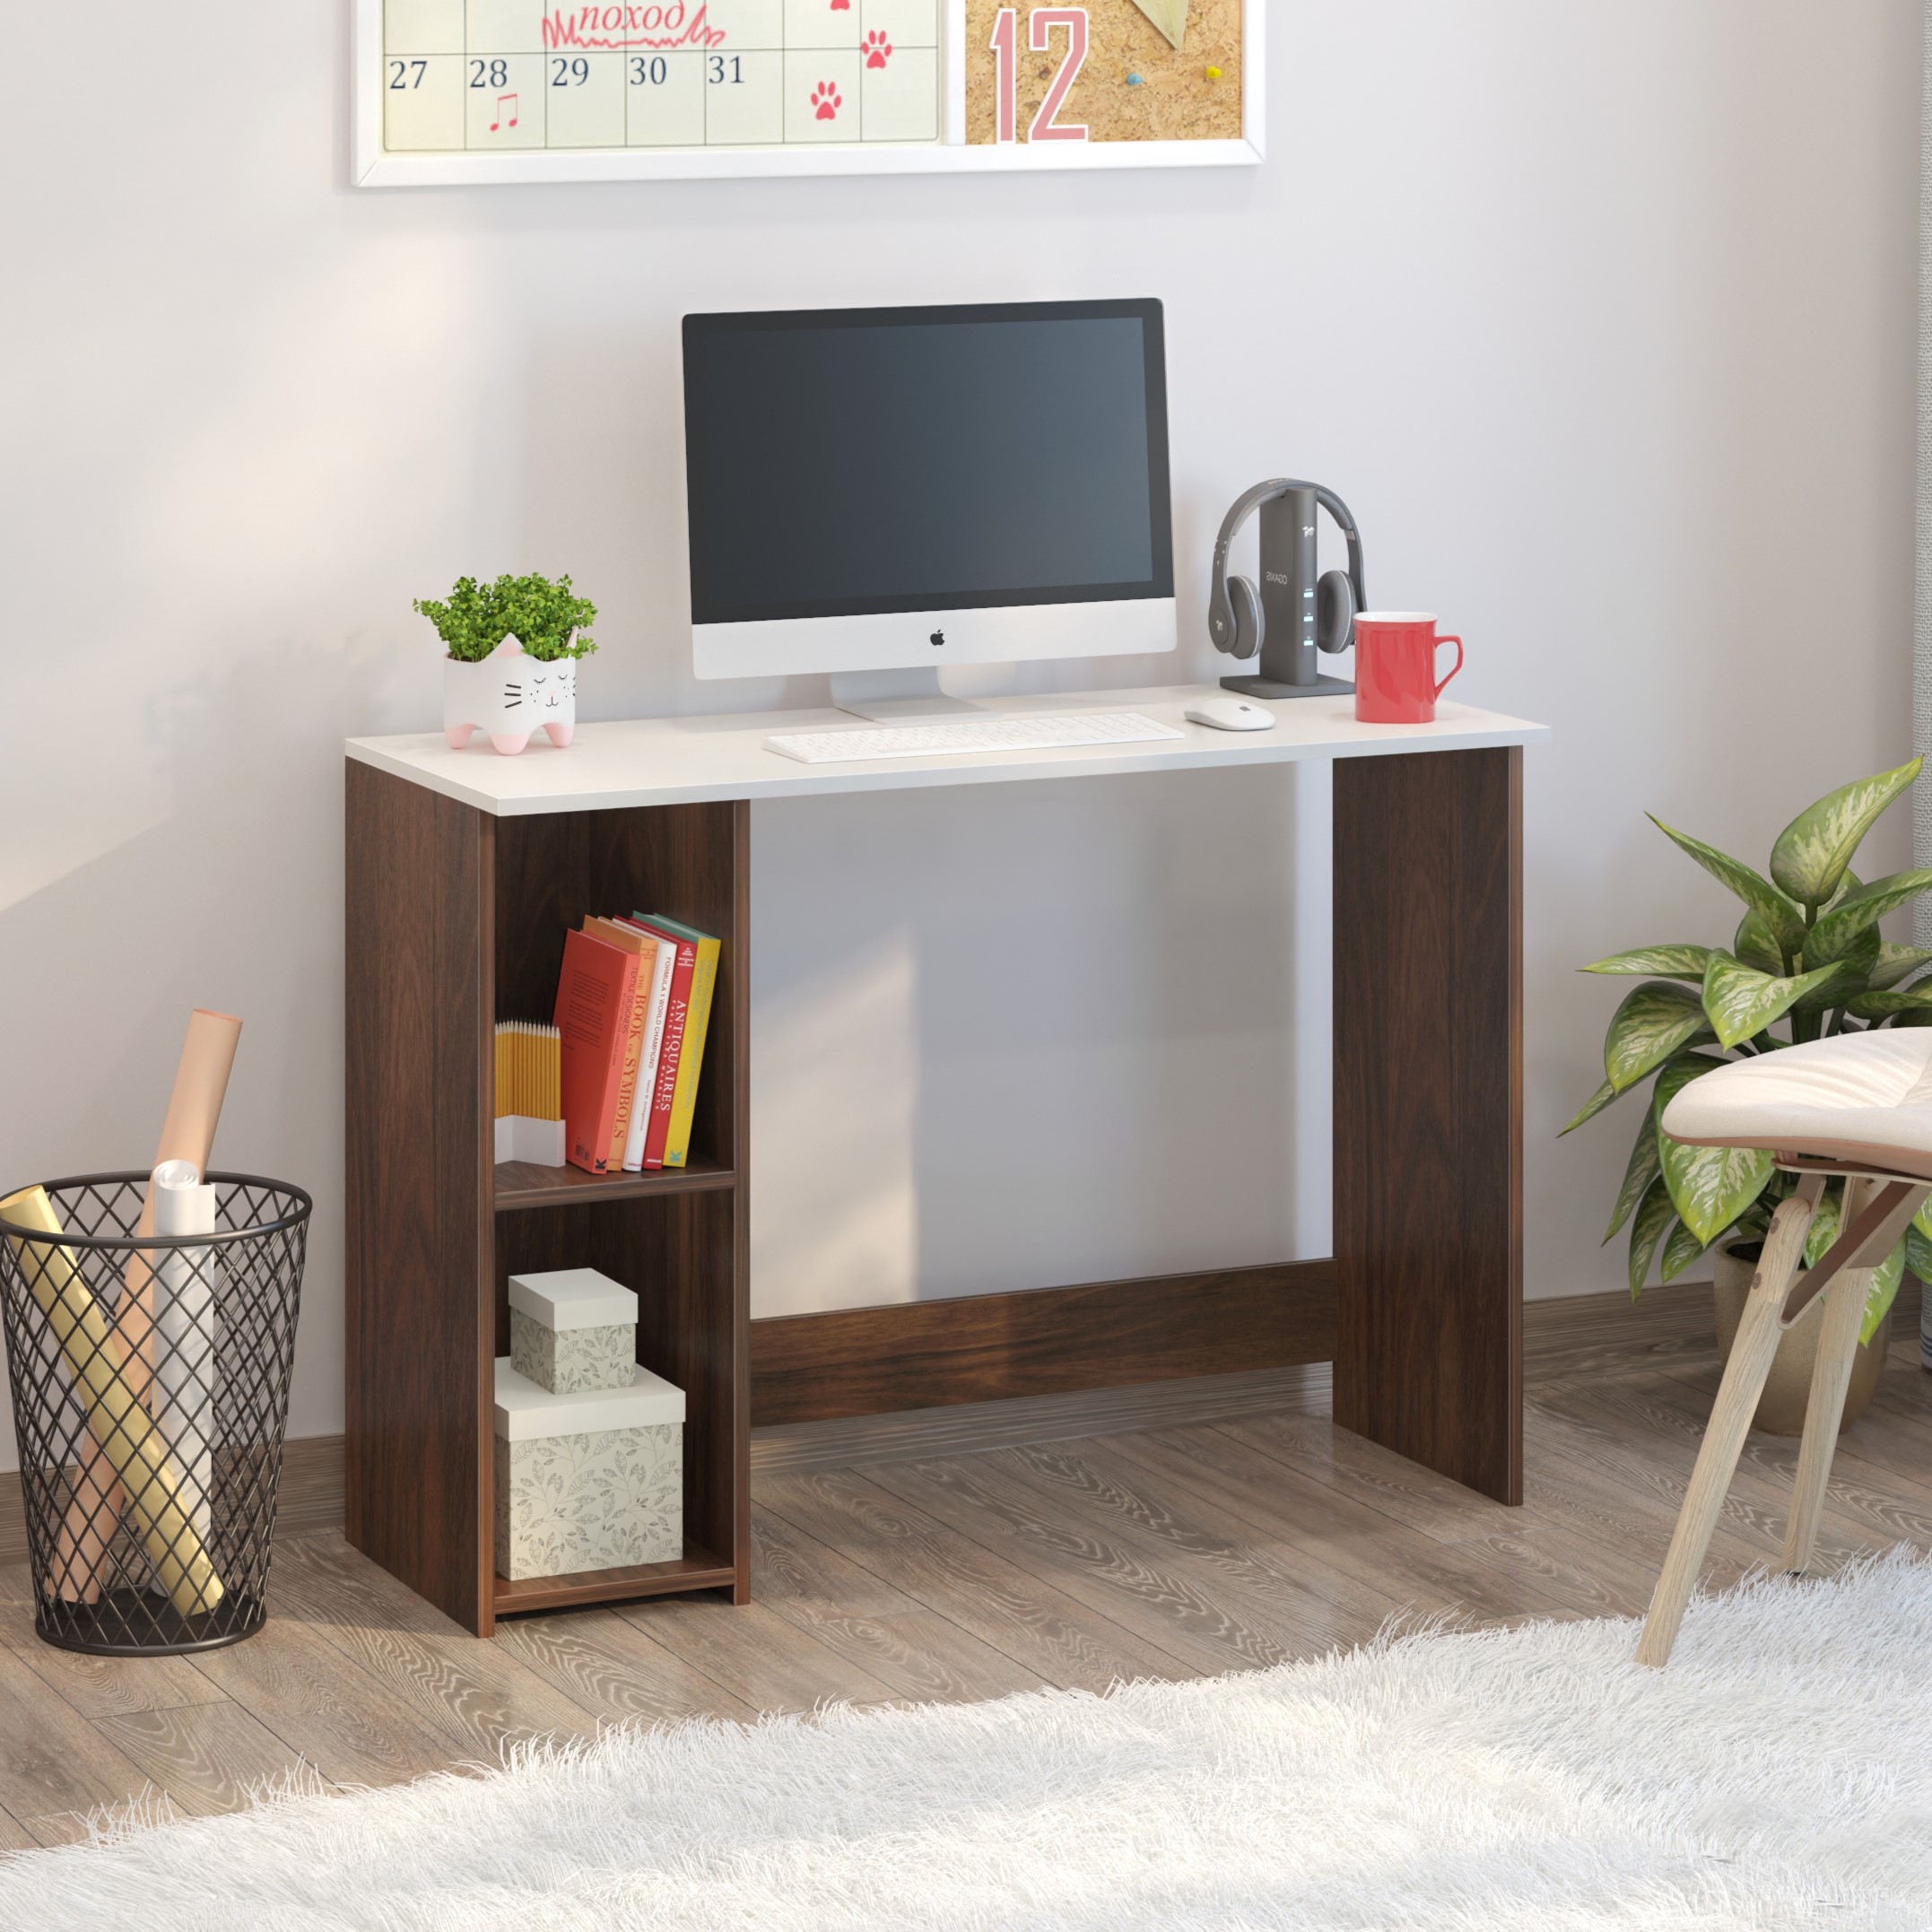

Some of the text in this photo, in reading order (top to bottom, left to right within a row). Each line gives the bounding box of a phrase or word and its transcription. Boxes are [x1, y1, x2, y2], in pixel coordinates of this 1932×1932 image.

[389, 56, 745, 90] 27 28 29 30 31
[989, 7, 1089, 144] 12
[661, 957, 671, 991] FORMULA
[622, 967, 638, 1034] TEXTILE DESIGNERS
[630, 995, 647, 1039] BOOK
[657, 998, 665, 1024] WORLD
[628, 1043, 633, 1054] OF
[648, 1027, 659, 1069] CHAMPIONS
[661, 1000, 686, 1110] ANTIQUAIRES
[614, 1058, 635, 1138] SYMBOLS
